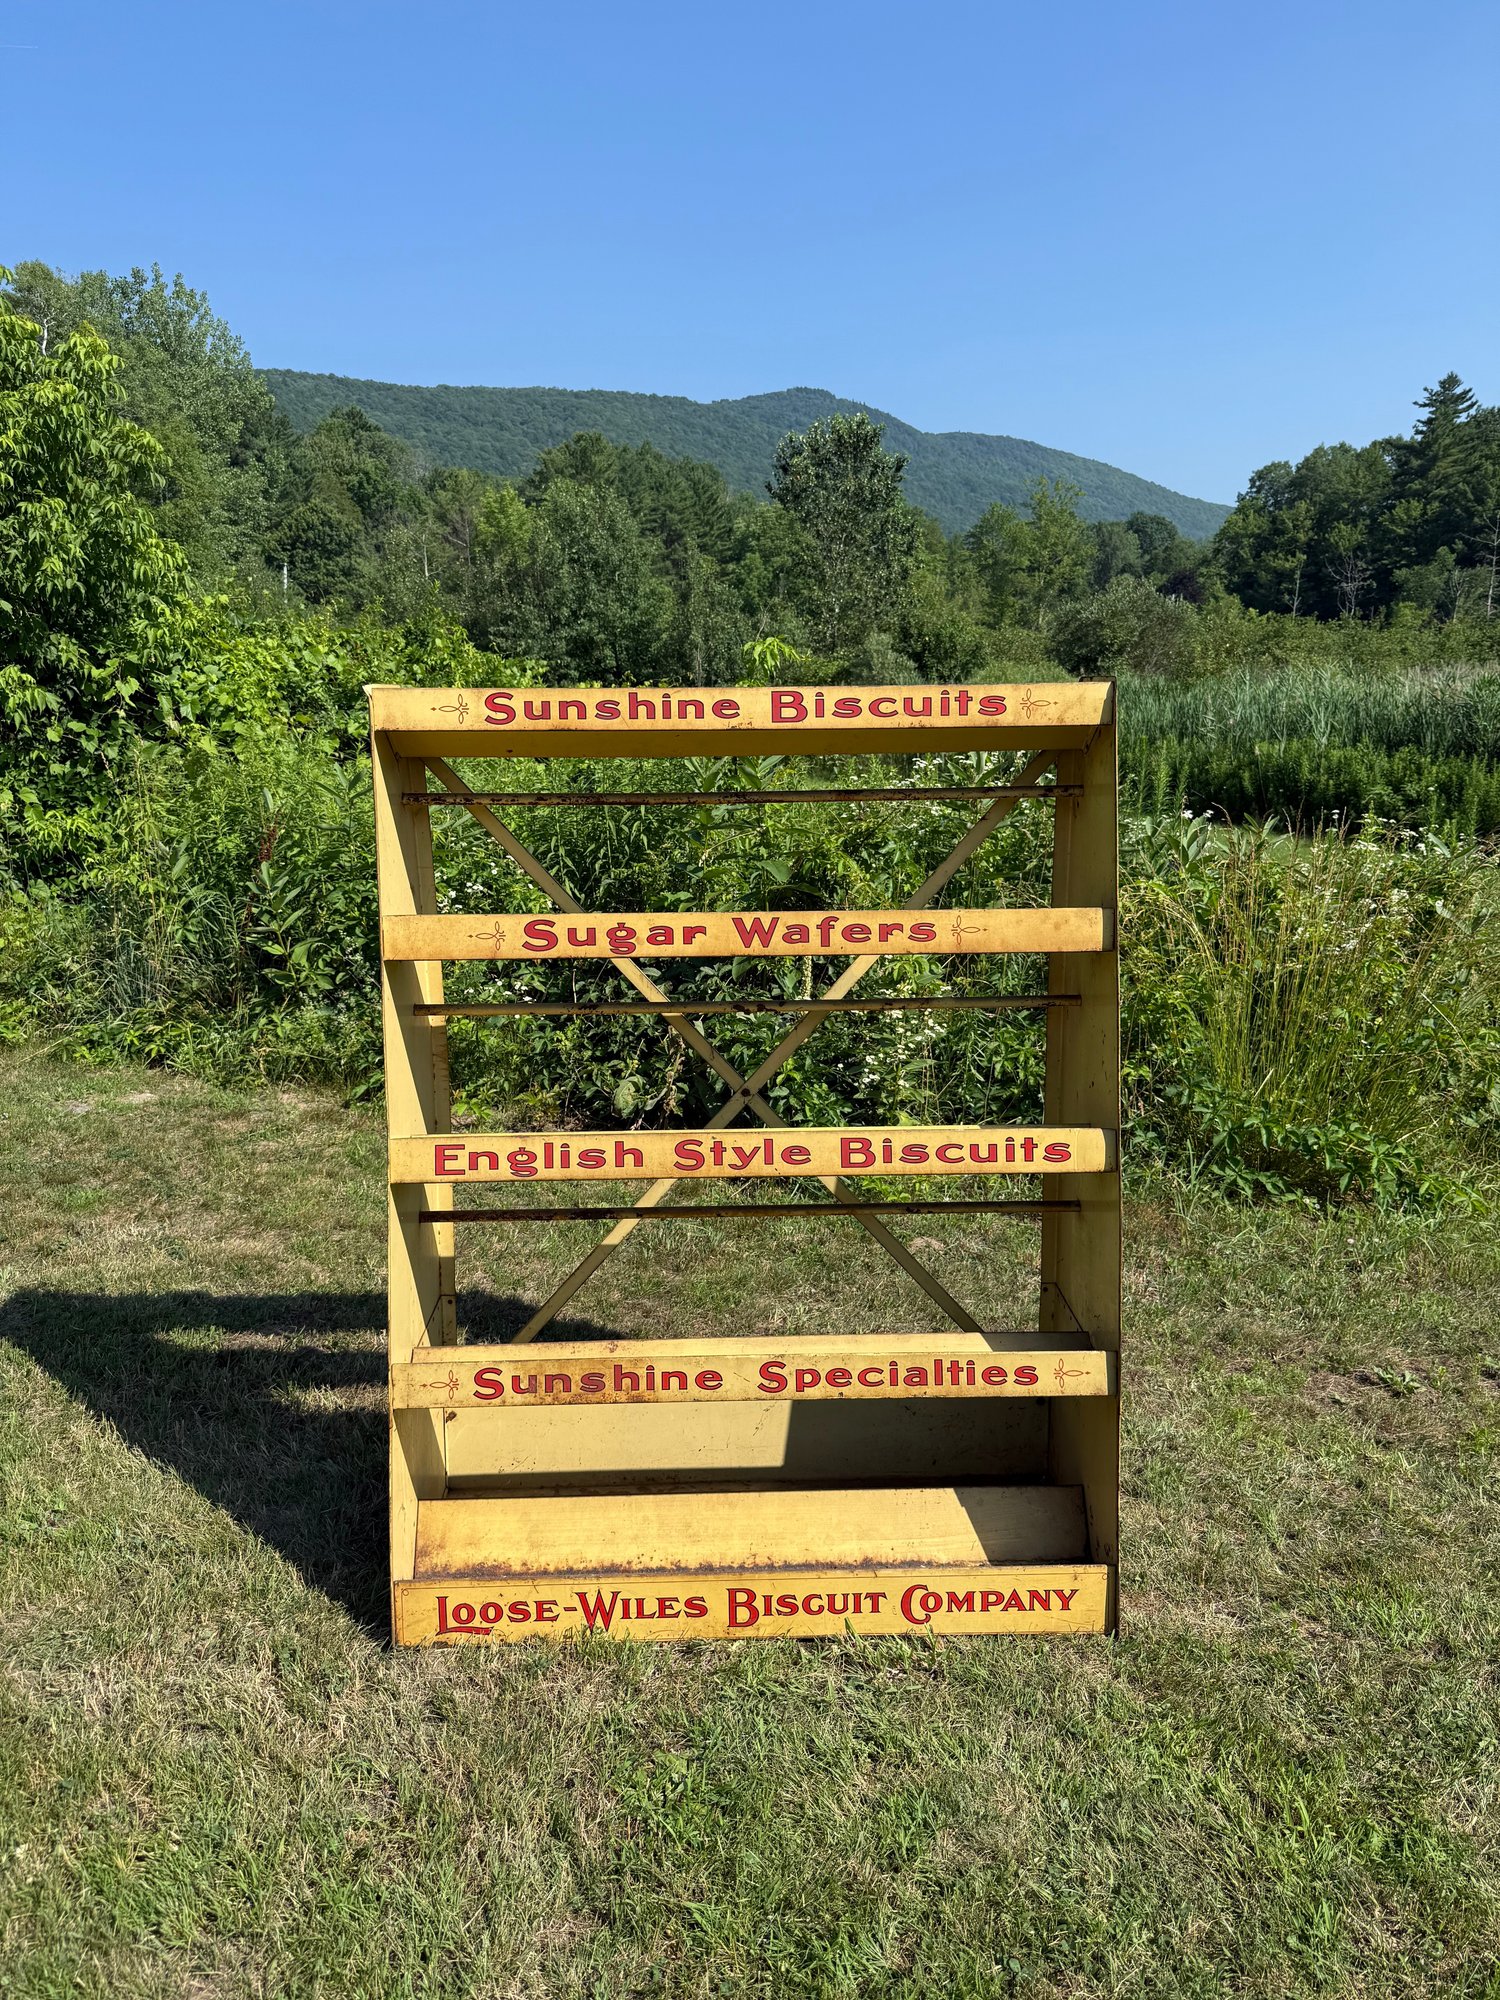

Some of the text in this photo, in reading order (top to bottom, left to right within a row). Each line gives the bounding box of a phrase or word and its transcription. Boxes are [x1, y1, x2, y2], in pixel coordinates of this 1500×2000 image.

[484, 689, 1007, 725] Sunshine Biscuits
[522, 915, 937, 955] Sugar Wafers
[434, 1136, 1072, 1177] English Style Biscuits
[472, 1358, 1039, 1400] Sunshine Specialties
